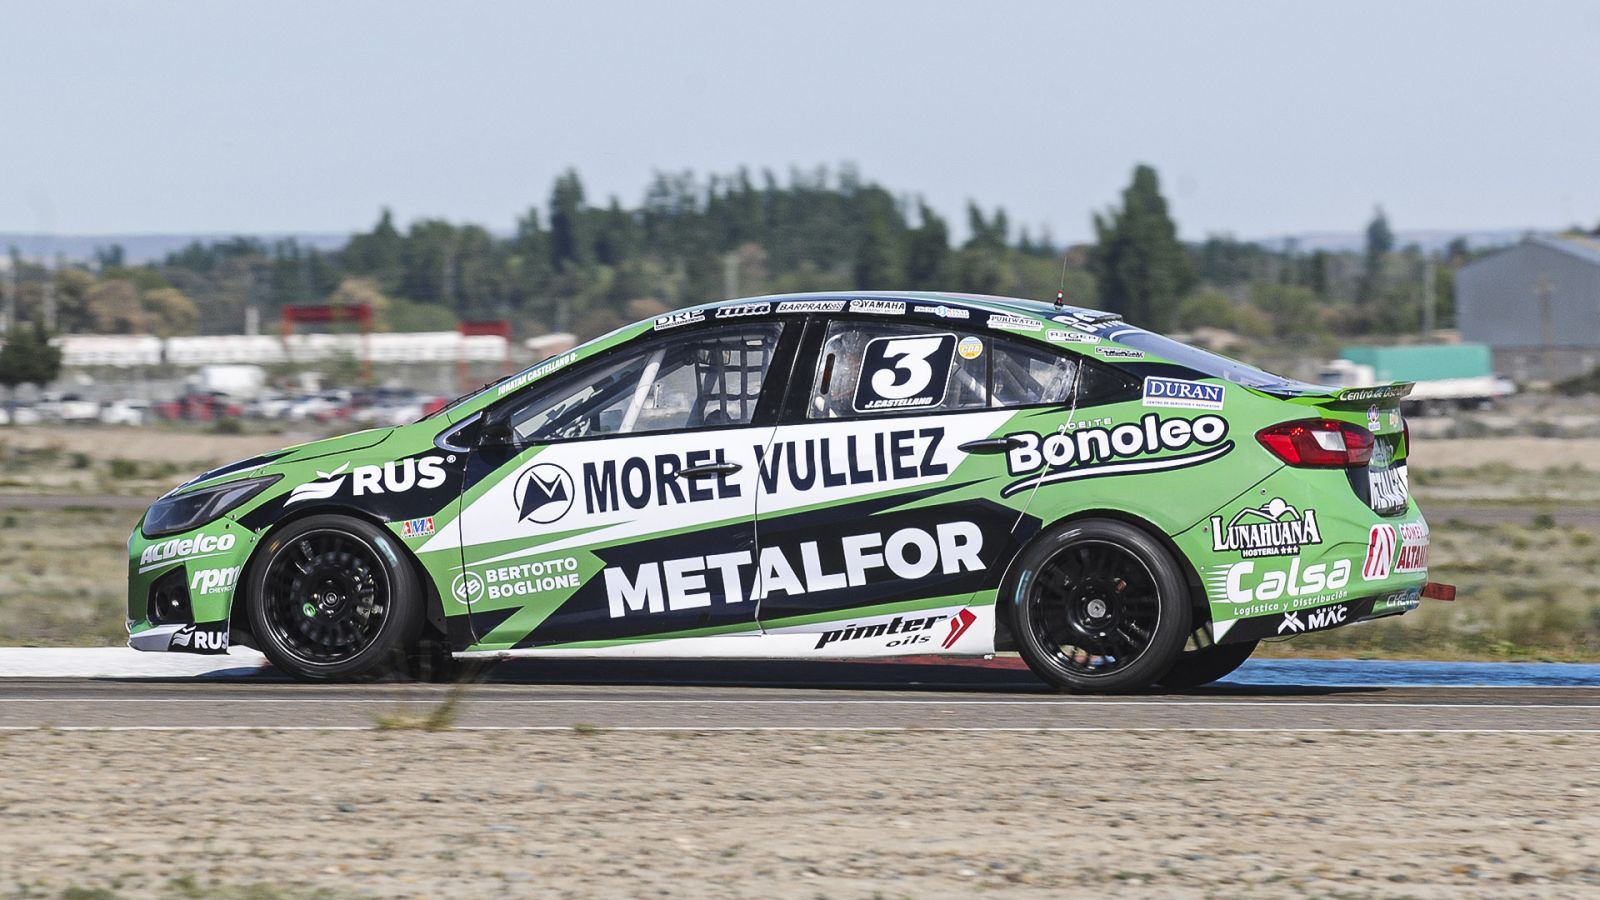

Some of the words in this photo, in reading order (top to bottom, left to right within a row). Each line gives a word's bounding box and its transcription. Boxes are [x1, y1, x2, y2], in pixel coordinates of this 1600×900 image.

[862, 301, 905, 312] YAMAHA
[527, 355, 570, 382] CASTELLANO
[871, 337, 943, 399] 3
[864, 396, 934, 409] J.CASTELLANO
[1149, 380, 1220, 401] DURAN
[1340, 389, 1373, 401] Centro
[1058, 417, 1113, 431] ACEITE
[1006, 414, 1228, 475] Bonoleo
[582, 447, 741, 515] MOREL
[753, 426, 949, 495] VULLIEZ
[402, 516, 434, 535] AMA
[1210, 509, 1322, 551] LUNAHUANA
[140, 533, 236, 566] ACDelco
[1242, 548, 1280, 558] HOSTERIA
[190, 565, 241, 595] rpm
[485, 557, 578, 583] BERTOTTO
[603, 520, 987, 618] METALFOR
[1226, 558, 1352, 604] Calsa
[488, 573, 581, 599] BOGLIONE
[1283, 601, 1289, 611] y
[1316, 604, 1342, 615] GRUPO
[885, 634, 931, 648] oils
